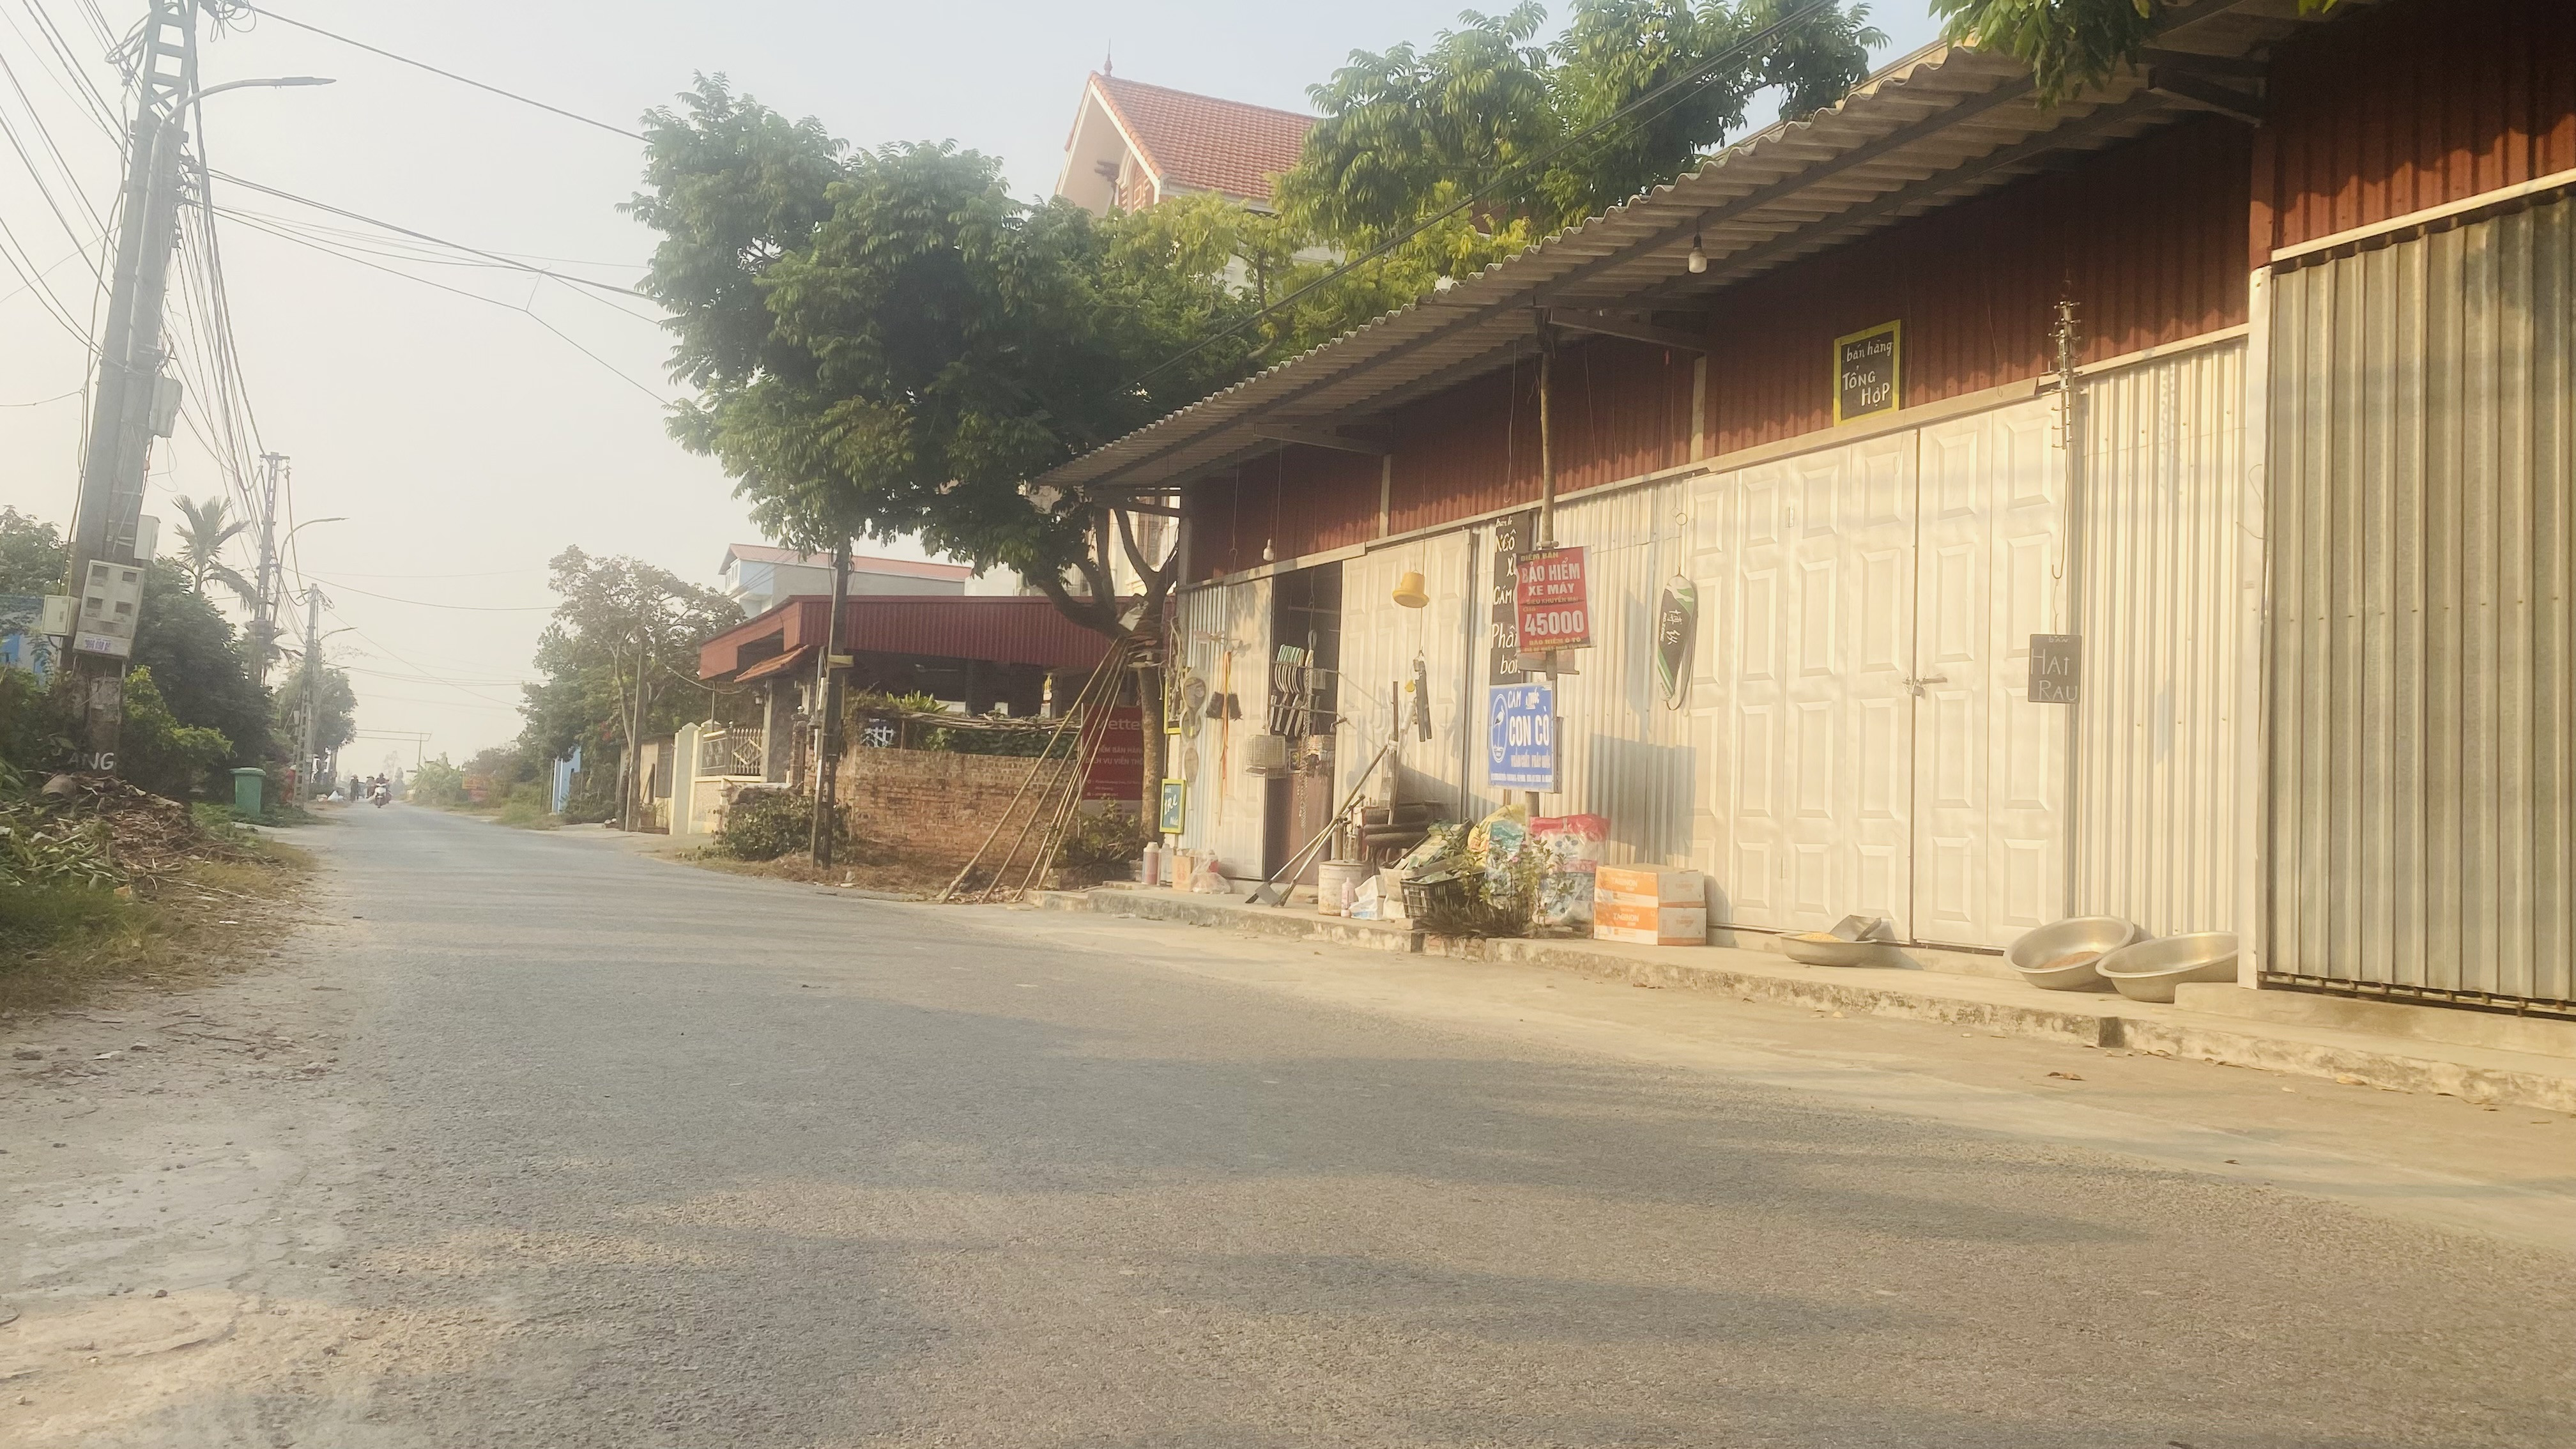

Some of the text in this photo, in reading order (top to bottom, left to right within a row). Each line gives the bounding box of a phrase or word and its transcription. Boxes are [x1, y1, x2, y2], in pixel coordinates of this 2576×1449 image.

[1846, 339, 1894, 362] bán hàng
[1842, 365, 1876, 390] TỔNG
[1861, 382, 1890, 407] HỢP
[1495, 528, 1517, 553] NGÔ
[1521, 556, 1581, 583] BẢO HIỂM
[1492, 585, 1514, 605] CÁM
[1528, 581, 1575, 596] XE MÁY
[1524, 610, 1584, 636] 45000
[1508, 687, 1522, 709] CÁM
[2039, 680, 2078, 701] RAU
[1508, 705, 1550, 747] CON CÒ
